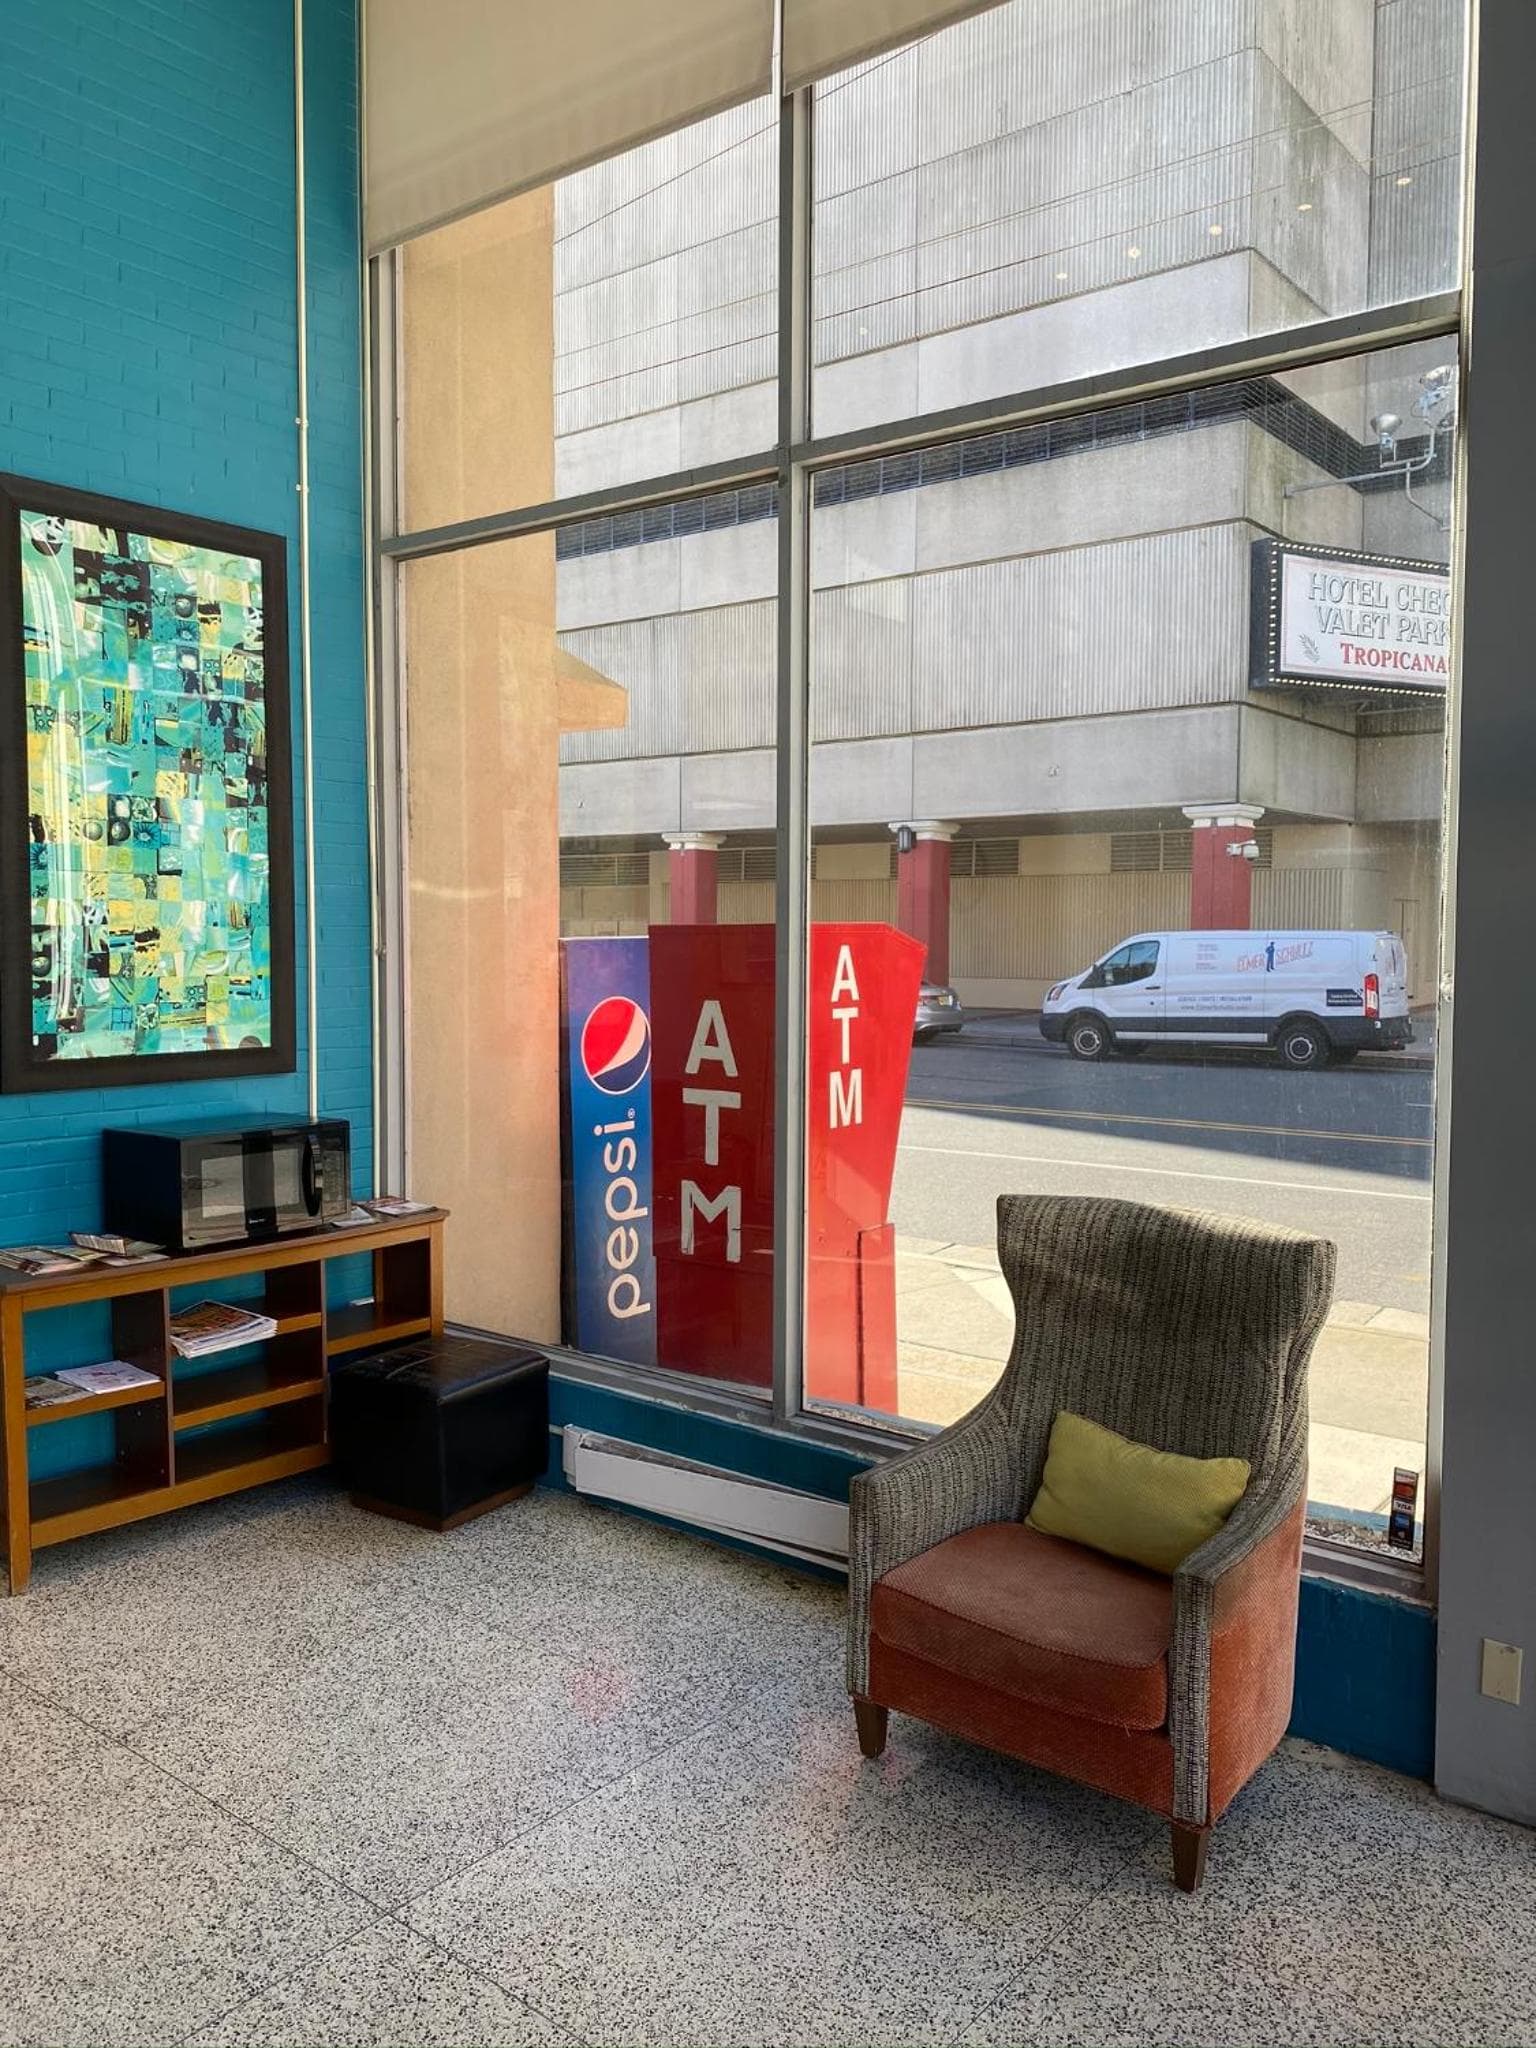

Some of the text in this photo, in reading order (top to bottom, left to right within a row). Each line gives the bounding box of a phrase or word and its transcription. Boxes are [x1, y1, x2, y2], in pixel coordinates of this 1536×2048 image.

[1308, 573, 1388, 609] HOTEL
[1317, 604, 1391, 640] VALET
[829, 943, 863, 1130] ATM
[593, 1119, 651, 1319] pepsi
[680, 999, 743, 1264] ATM
